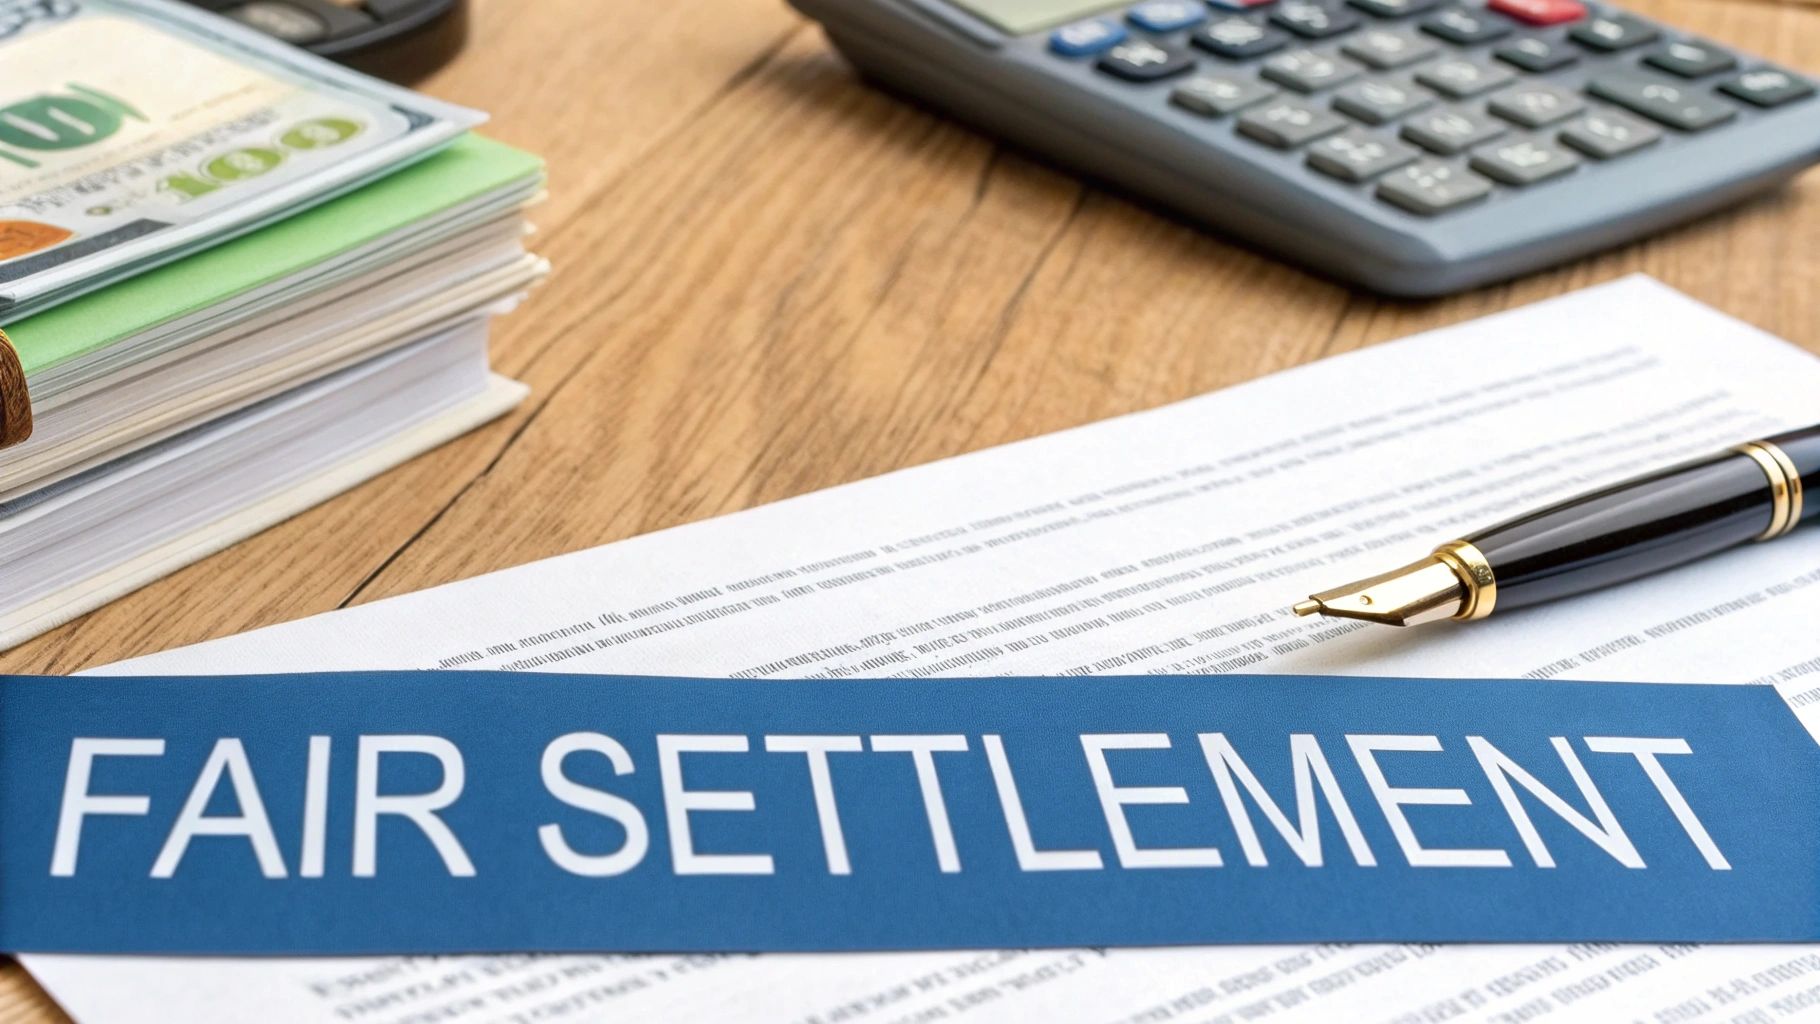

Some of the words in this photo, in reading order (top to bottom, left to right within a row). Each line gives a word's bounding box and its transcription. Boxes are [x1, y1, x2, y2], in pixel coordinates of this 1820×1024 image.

[163, 117, 362, 198] 100
[51, 735, 475, 877] FAIR
[538, 731, 1732, 875] SETTLEMENT
